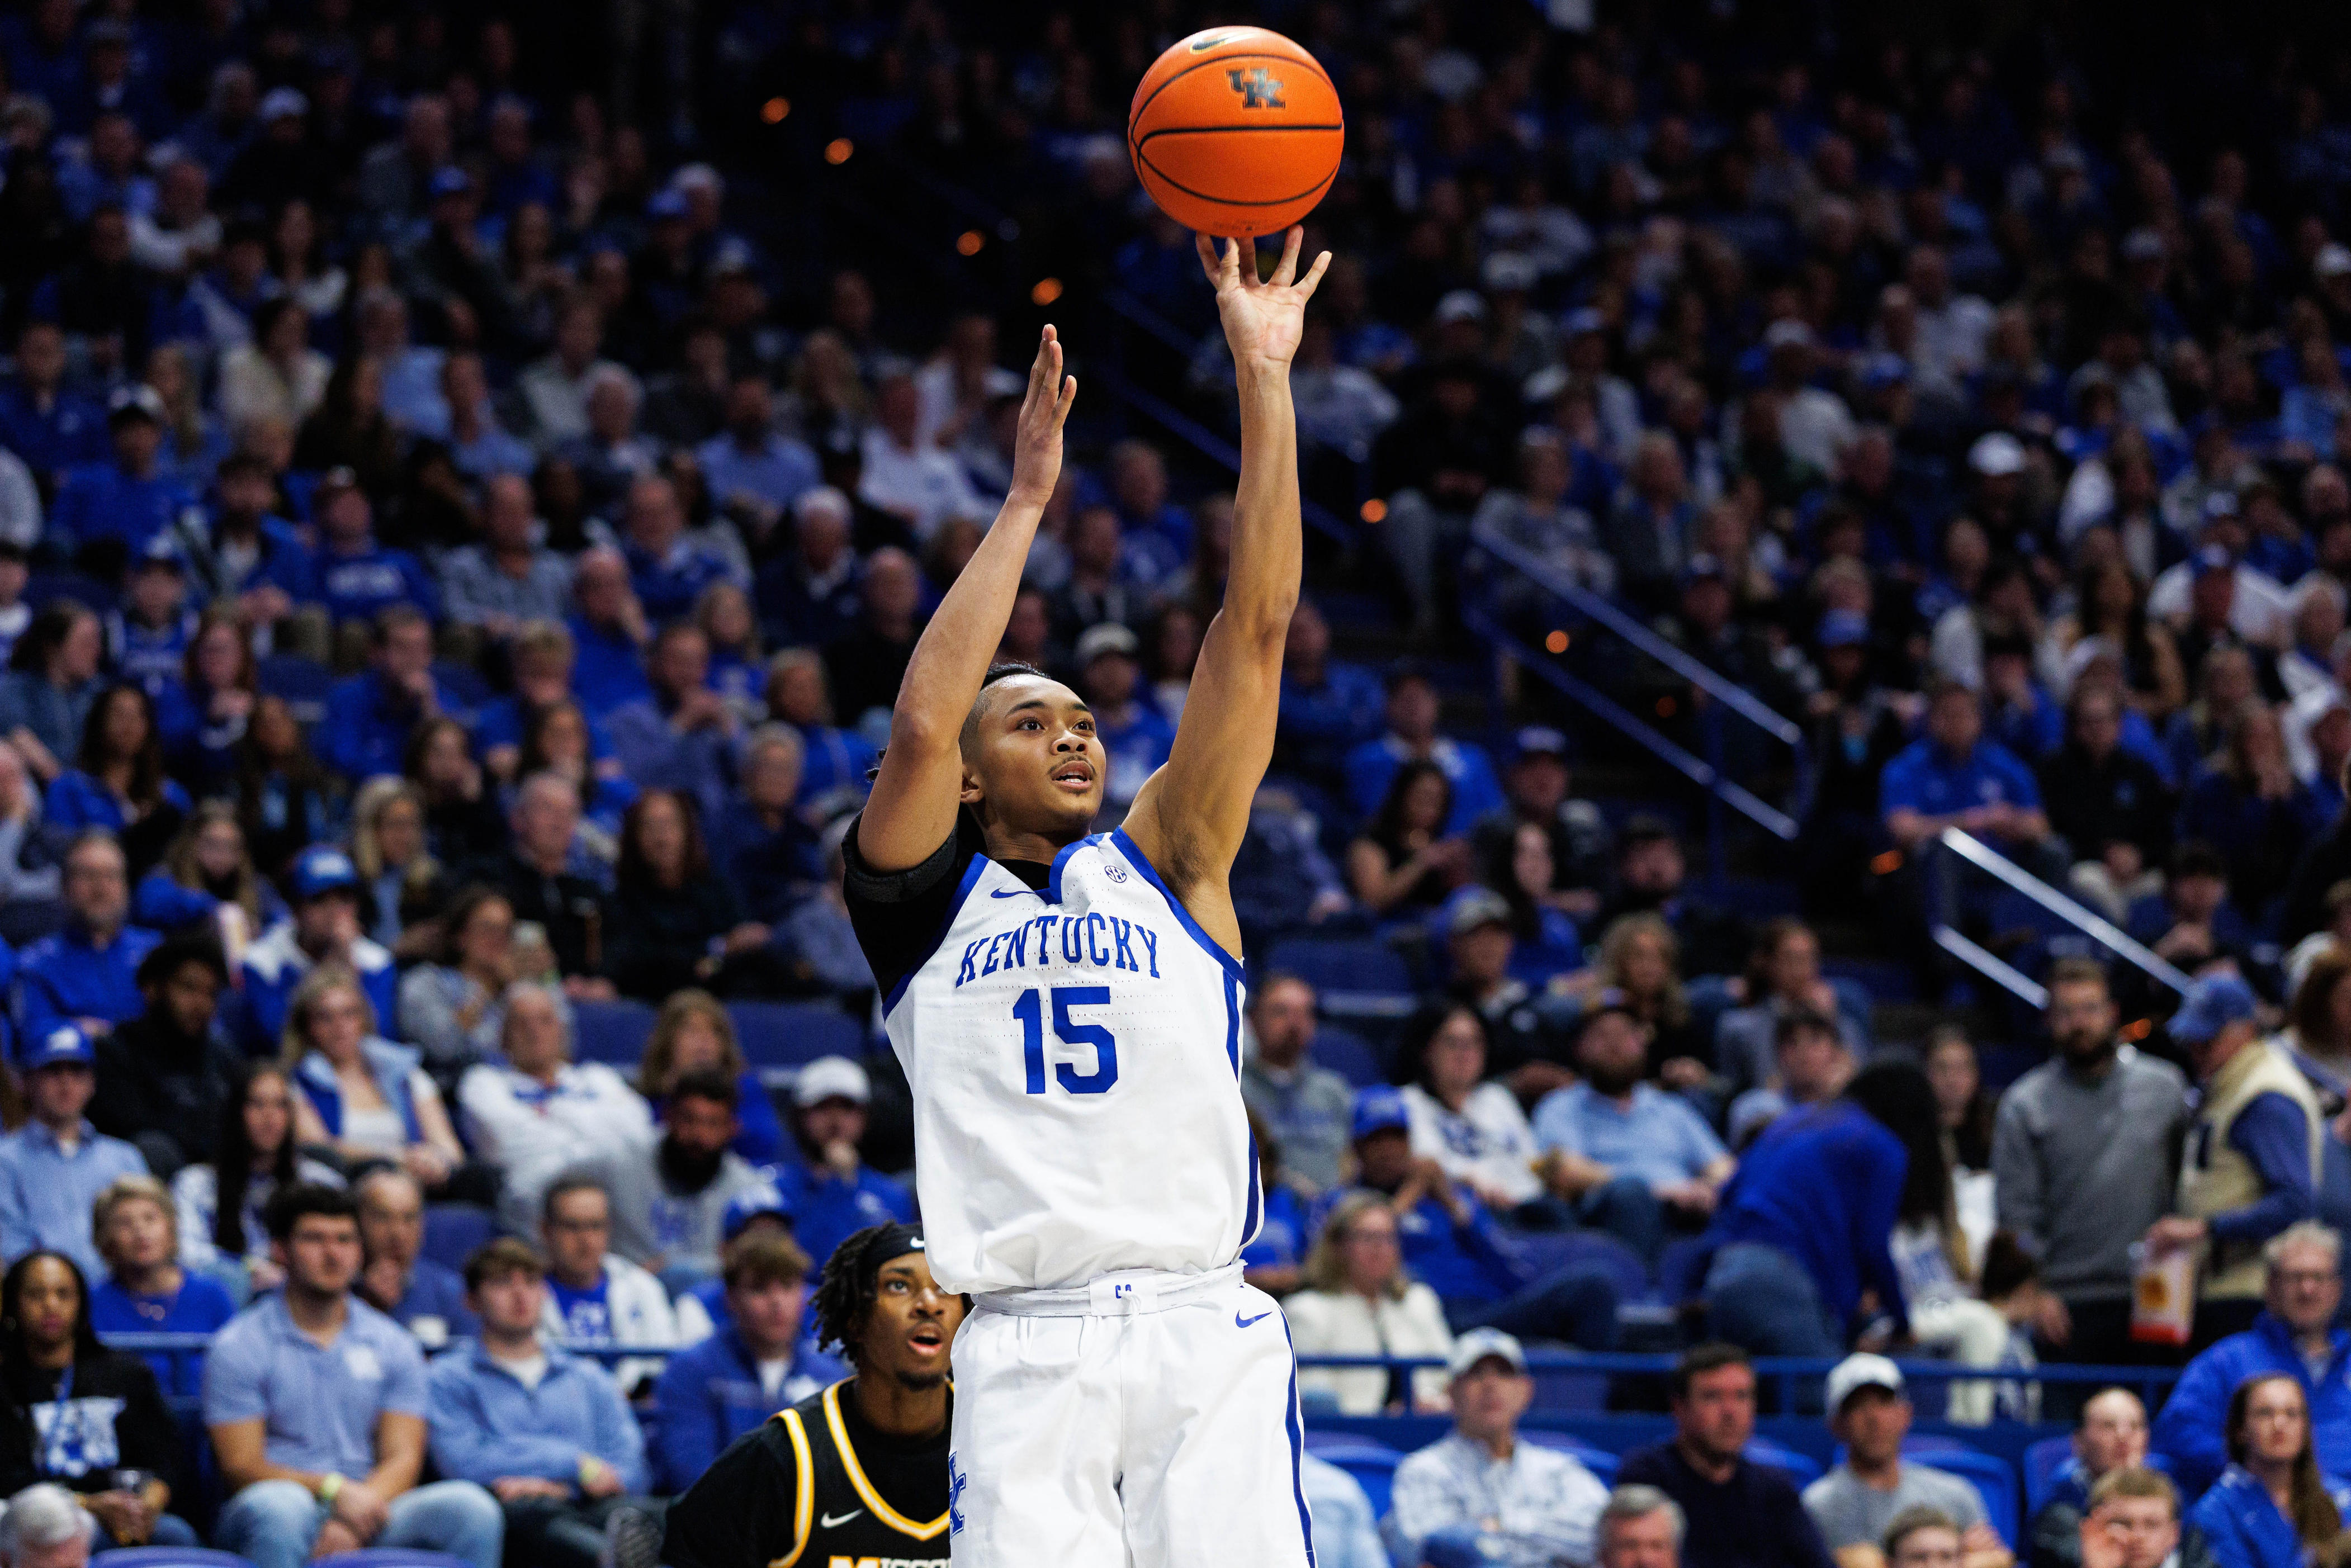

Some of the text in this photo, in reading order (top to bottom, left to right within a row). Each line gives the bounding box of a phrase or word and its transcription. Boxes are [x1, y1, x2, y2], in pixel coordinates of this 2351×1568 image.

[1226, 68, 1285, 109] UK
[1104, 865, 1127, 883] SEC
[955, 912, 1160, 988] KENTUCKY
[1013, 986, 1118, 1094] 15
